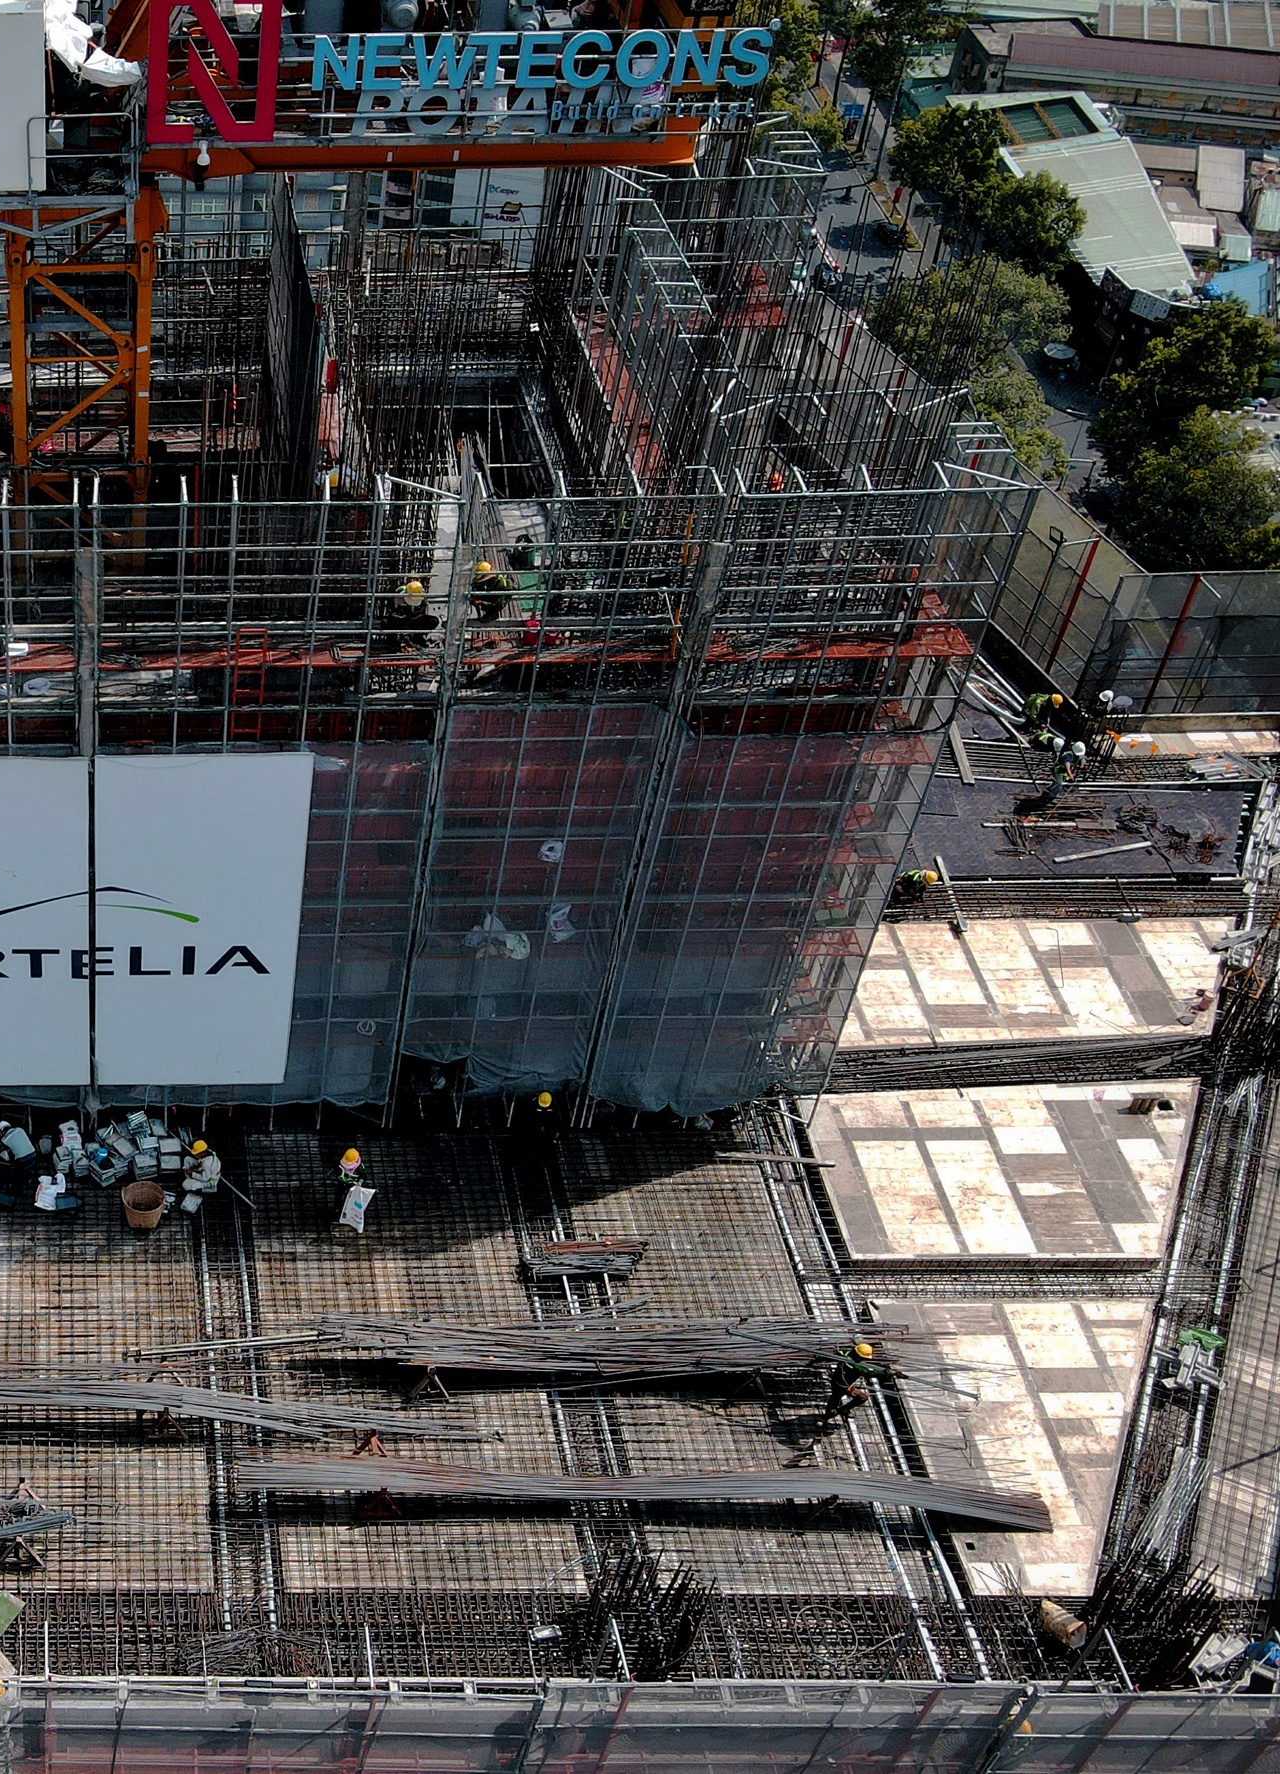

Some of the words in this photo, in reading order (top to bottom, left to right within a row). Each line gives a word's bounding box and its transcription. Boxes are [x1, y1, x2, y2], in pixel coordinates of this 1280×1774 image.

[312, 27, 774, 91] NEWTECONS
[550, 100, 620, 121] Build
[632, 104, 663, 120] on
[675, 97, 755, 118] trust
[483, 212, 521, 222] SHARP
